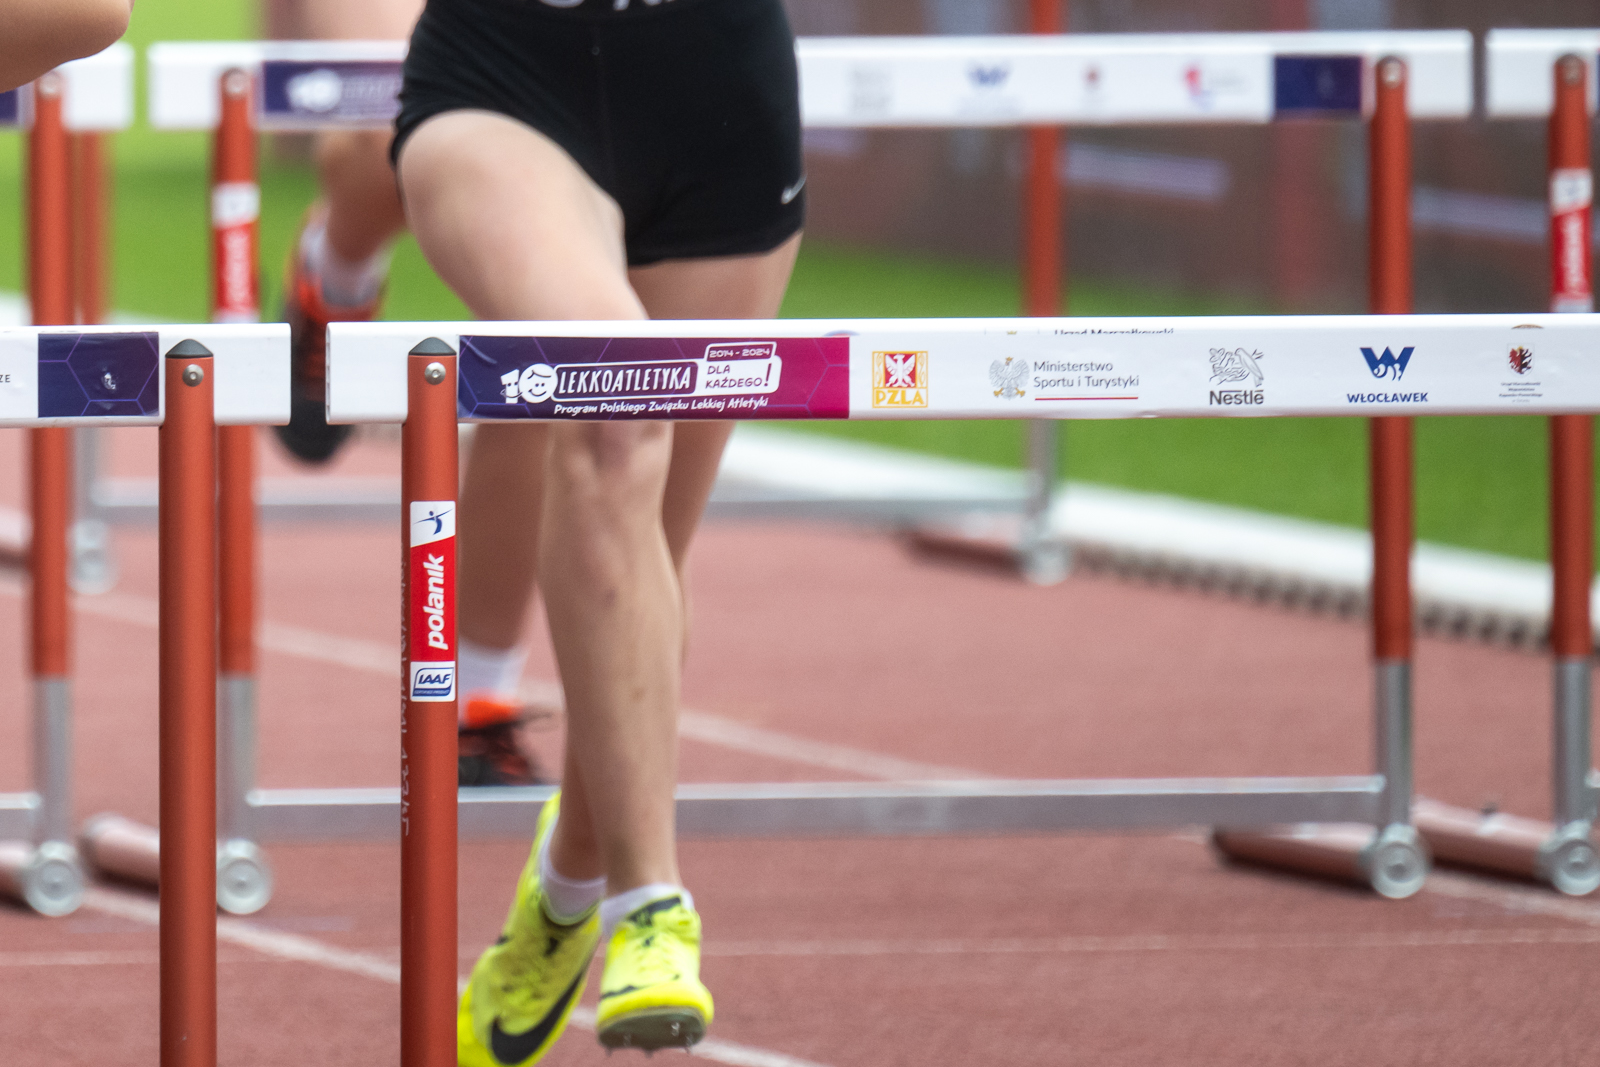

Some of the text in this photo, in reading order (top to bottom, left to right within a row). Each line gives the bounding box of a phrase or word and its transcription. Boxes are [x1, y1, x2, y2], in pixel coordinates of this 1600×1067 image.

[709, 349, 733, 358] 2014
[742, 347, 771, 357] 2024
[707, 365, 731, 375] DLA
[1034, 360, 1113, 373] Ministerstwo
[558, 366, 691, 395] LEKKOATLETYKA
[705, 363, 773, 389] KAŻDEGO!
[1034, 376, 1075, 390] Sportu
[1084, 374, 1140, 389] Turystyki
[875, 390, 925, 405] PZLA
[1209, 389, 1265, 406] Nestlé
[1347, 392, 1429, 403] WŁOCŁAWEK
[554, 396, 769, 416] Program Polskiego Związku Lekkiej Atletyki
[422, 553, 449, 651] polanik
[418, 673, 451, 684] IAAF
